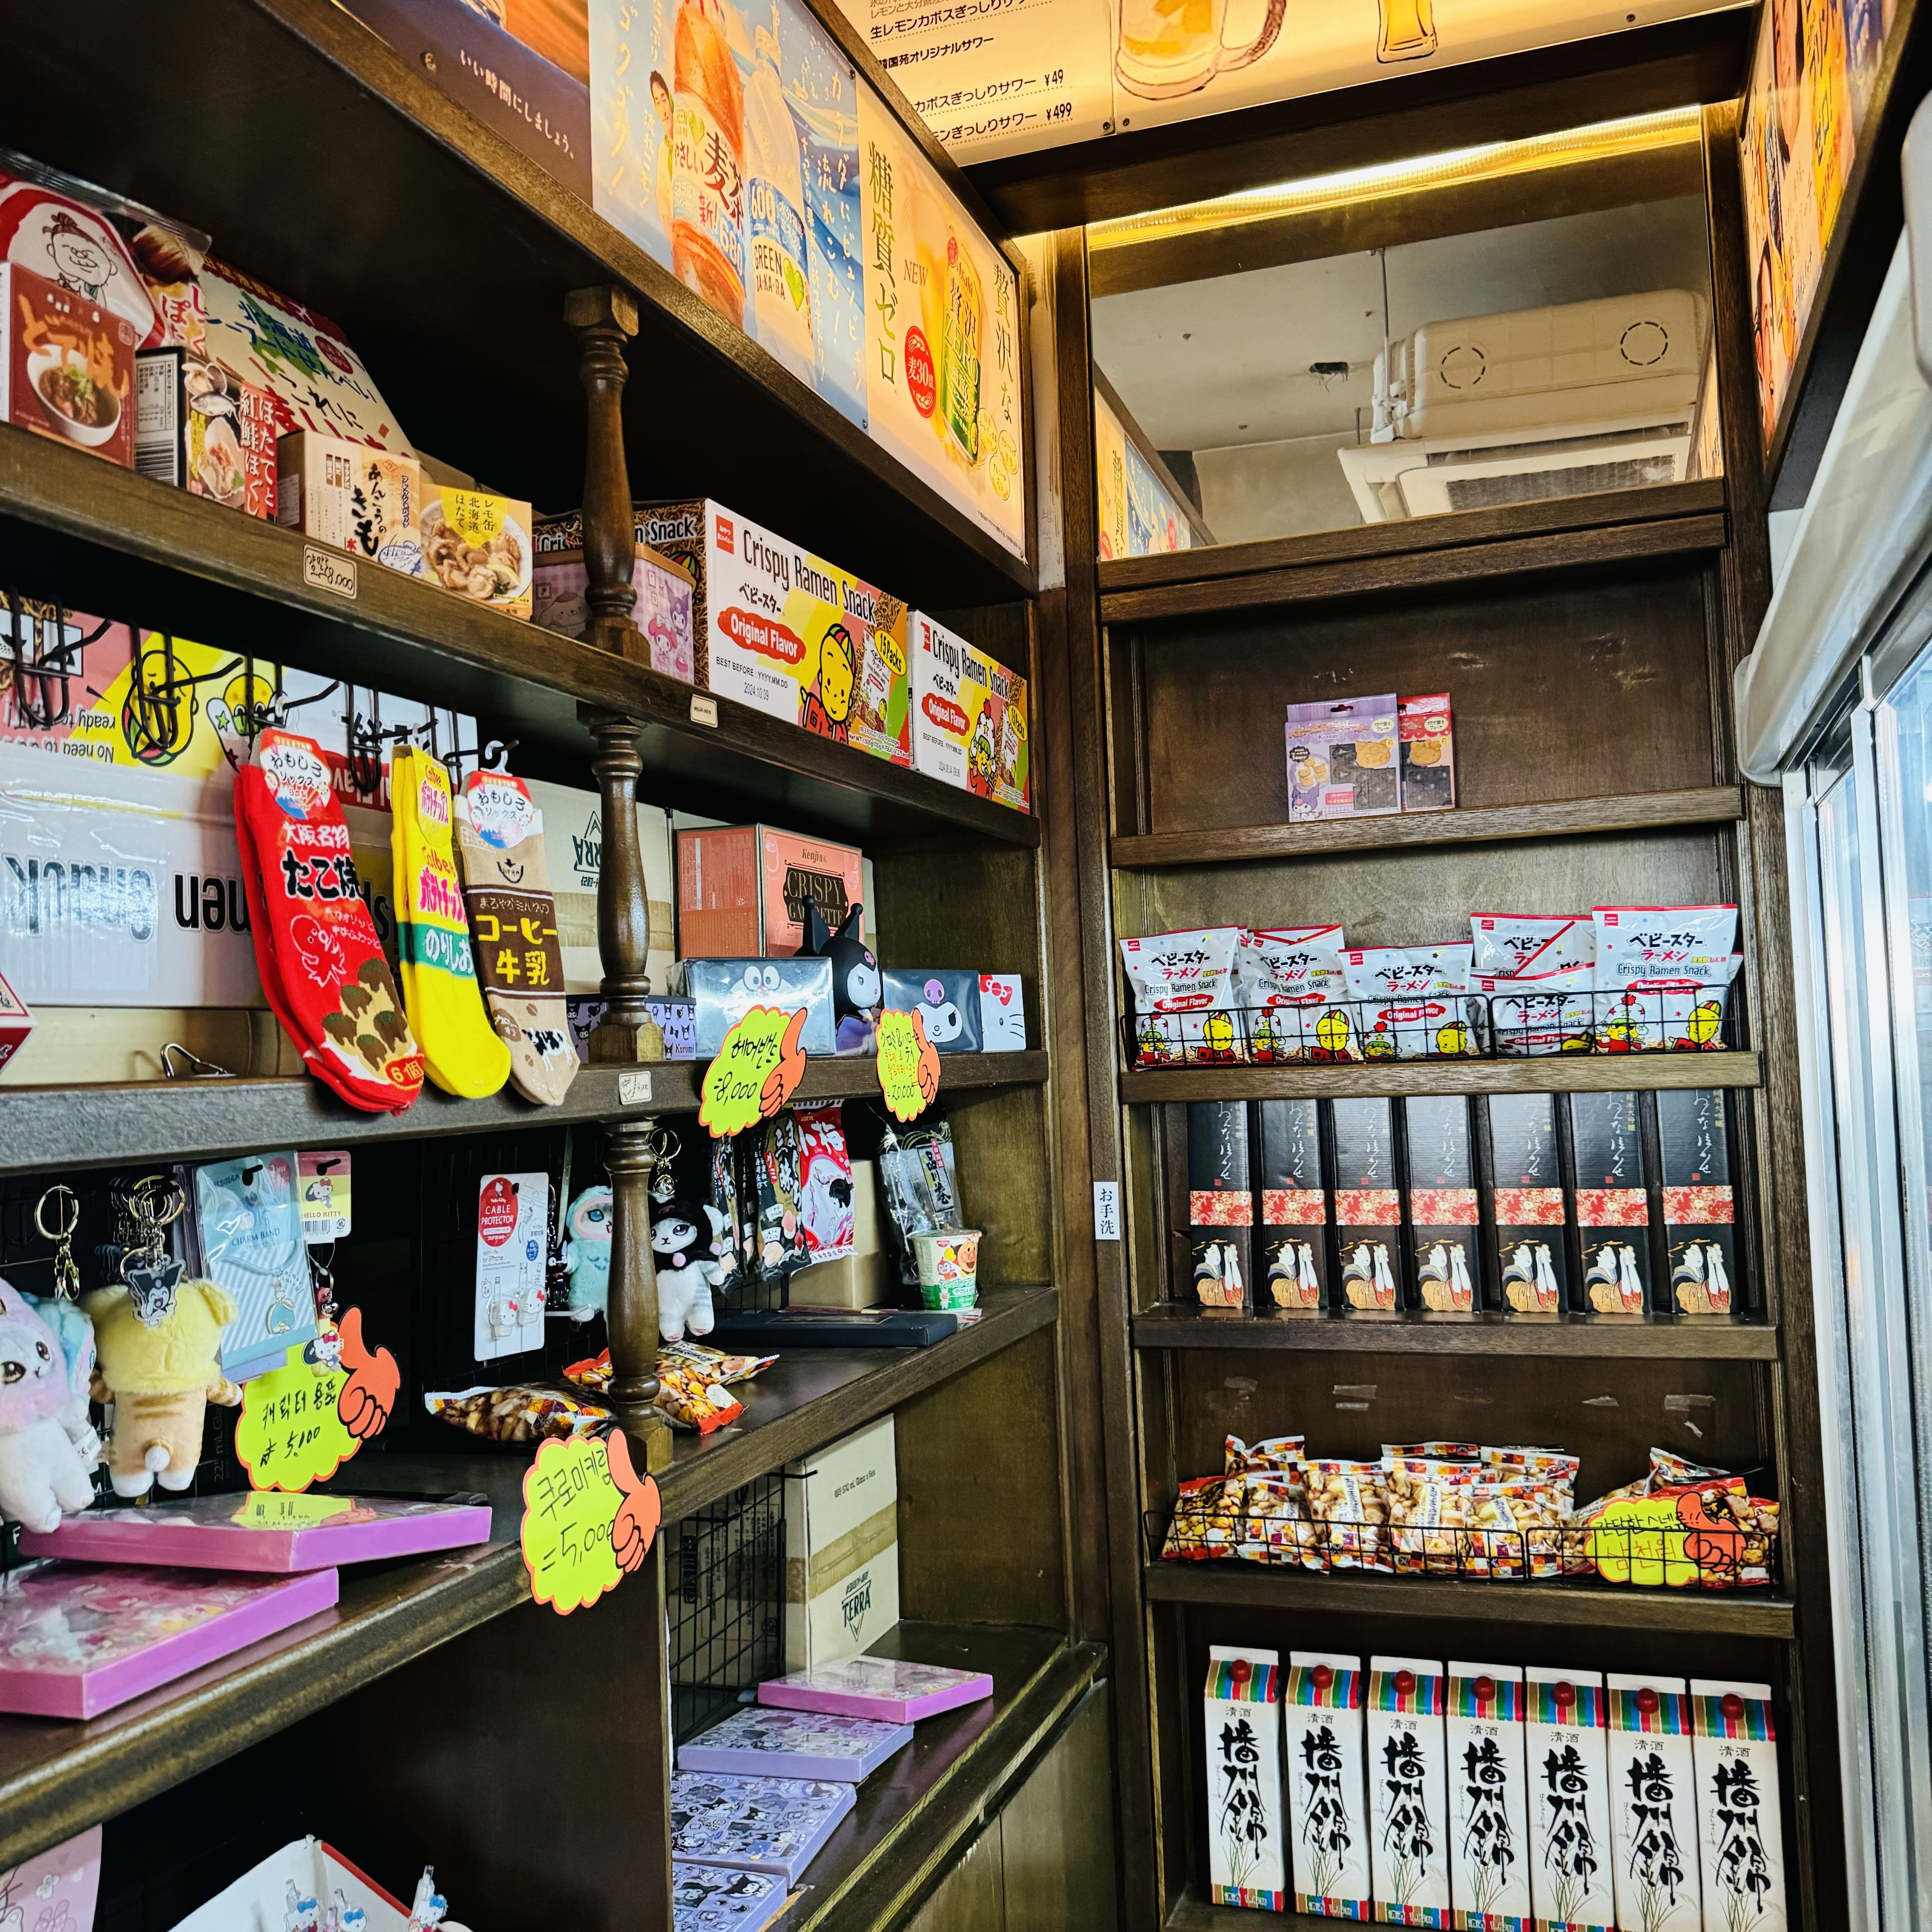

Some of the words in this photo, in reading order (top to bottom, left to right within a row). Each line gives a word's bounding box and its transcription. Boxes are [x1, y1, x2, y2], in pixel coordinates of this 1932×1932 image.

[1046, 102, 1072, 121] ¥499
[751, 185, 775, 225] 600
[719, 217, 743, 277] 680
[754, 244, 782, 277] GREEN
[867, 141, 898, 386] 糖質ゼロ
[903, 259, 929, 287] NEW
[945, 308, 979, 387] ZERO
[239, 386, 264, 516] 紅鮭ほぐし
[258, 395, 276, 509] ほたてと
[455, 494, 466, 529] ほたて
[469, 497, 480, 534] 北海道
[483, 499, 495, 533] レモ缶
[650, 516, 695, 540] Snack
[743, 529, 790, 593] Crispy
[795, 555, 837, 606] Ramen
[842, 580, 877, 625] Snack
[739, 583, 782, 615] ベビースター
[731, 613, 768, 647] Original
[769, 625, 798, 657] Flavor
[716, 656, 731, 668] BEST
[732, 662, 754, 677] BEFORE
[933, 630, 960, 679] Crispy
[961, 647, 987, 688] Ramen
[990, 665, 1009, 701] Snack
[933, 673, 956, 697] ベビースター
[928, 697, 949, 721] Original
[949, 710, 966, 731] Flavor
[96, 744, 115, 764] No
[282, 820, 350, 850] 大阪名物
[787, 870, 842, 906] CRISPY
[475, 915, 557, 945] コーヒー
[1630, 933, 1703, 948] ベビースター
[425, 928, 474, 975] のりしお
[1151, 950, 1210, 966] ベビースター
[1641, 950, 1688, 961] ラーメン
[495, 948, 550, 986] 牛乳
[1162, 968, 1201, 980] ラーメン
[1270, 968, 1307, 981] ラーメン
[1375, 965, 1443, 980] ベビースター
[1617, 964, 1646, 977] Crispy
[1650, 965, 1680, 975] Ramen
[1684, 965, 1711, 976] Snack
[1145, 984, 1168, 995] Crispy
[1172, 982, 1196, 992] Ramen
[1198, 979, 1217, 989] Snack
[1307, 978, 1329, 988] Snack
[1387, 980, 1431, 992] ラーメン
[1189, 997, 1208, 1007] Flavor
[1387, 1008, 1417, 1020] Original
[391, 1061, 423, 1081] 6個
[798, 1120, 845, 1157] 小梅
[481, 1215, 514, 1226] PROTECTOR
[485, 1205, 511, 1215] CABLE
[1099, 1188, 1114, 1236] お手洗
[231, 1233, 258, 1247] CHARM
[260, 1228, 280, 1239] BAND
[262, 1388, 308, 1431] 캐릭터
[313, 1376, 337, 1411] 용품
[842, 1586, 871, 1628] TERRA
[1225, 1706, 1252, 1717] 清酒
[1307, 1713, 1334, 1725] 清酒
[1389, 1718, 1418, 1731] 清酒
[1470, 1724, 1498, 1736] 清酒
[1550, 1731, 1580, 1743] 清酒
[1634, 1739, 1664, 1752] 清酒
[1719, 1744, 1750, 1757] 清酒
